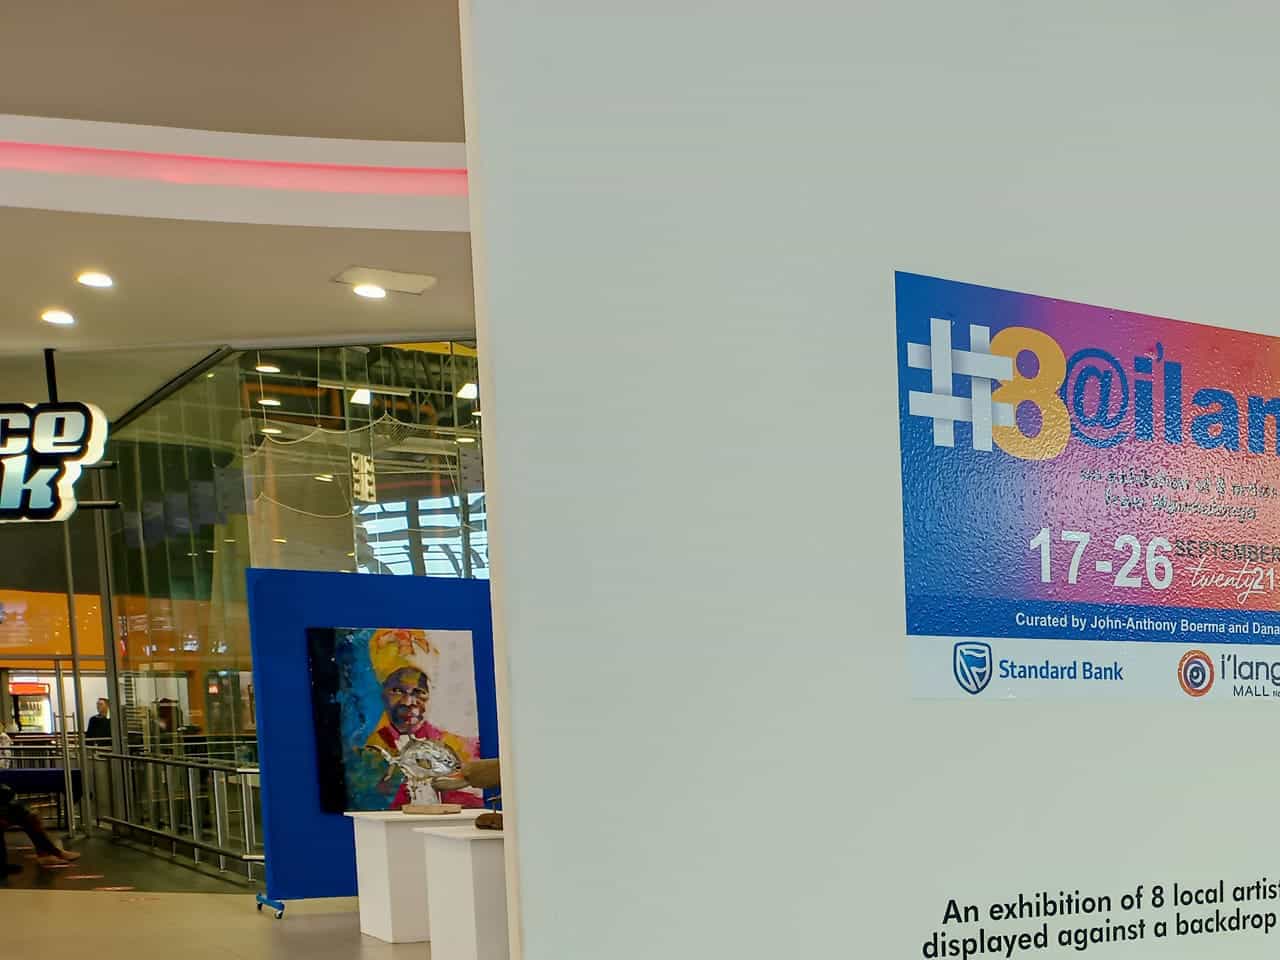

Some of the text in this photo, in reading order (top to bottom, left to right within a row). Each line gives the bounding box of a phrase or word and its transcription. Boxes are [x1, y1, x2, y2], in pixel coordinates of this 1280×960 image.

[1030, 528, 1174, 590] 17-26
[1015, 612, 1068, 628] Curated
[1071, 616, 1087, 631] by
[1090, 615, 1177, 634] John-Anthony
[1180, 619, 1225, 634] Boerma
[1228, 621, 1249, 634] and
[1252, 623, 1280, 635] Dana
[999, 659, 1124, 681] Standard Bank
[1233, 685, 1269, 697] MALL
[942, 899, 979, 924] An
[989, 890, 1112, 921] exhibition
[1120, 885, 1143, 910] of
[1151, 885, 1165, 908] 8
[1173, 879, 1224, 906] local
[1058, 918, 1146, 950] against
[1154, 921, 1167, 937] a
[1176, 908, 1277, 935] backdrop
